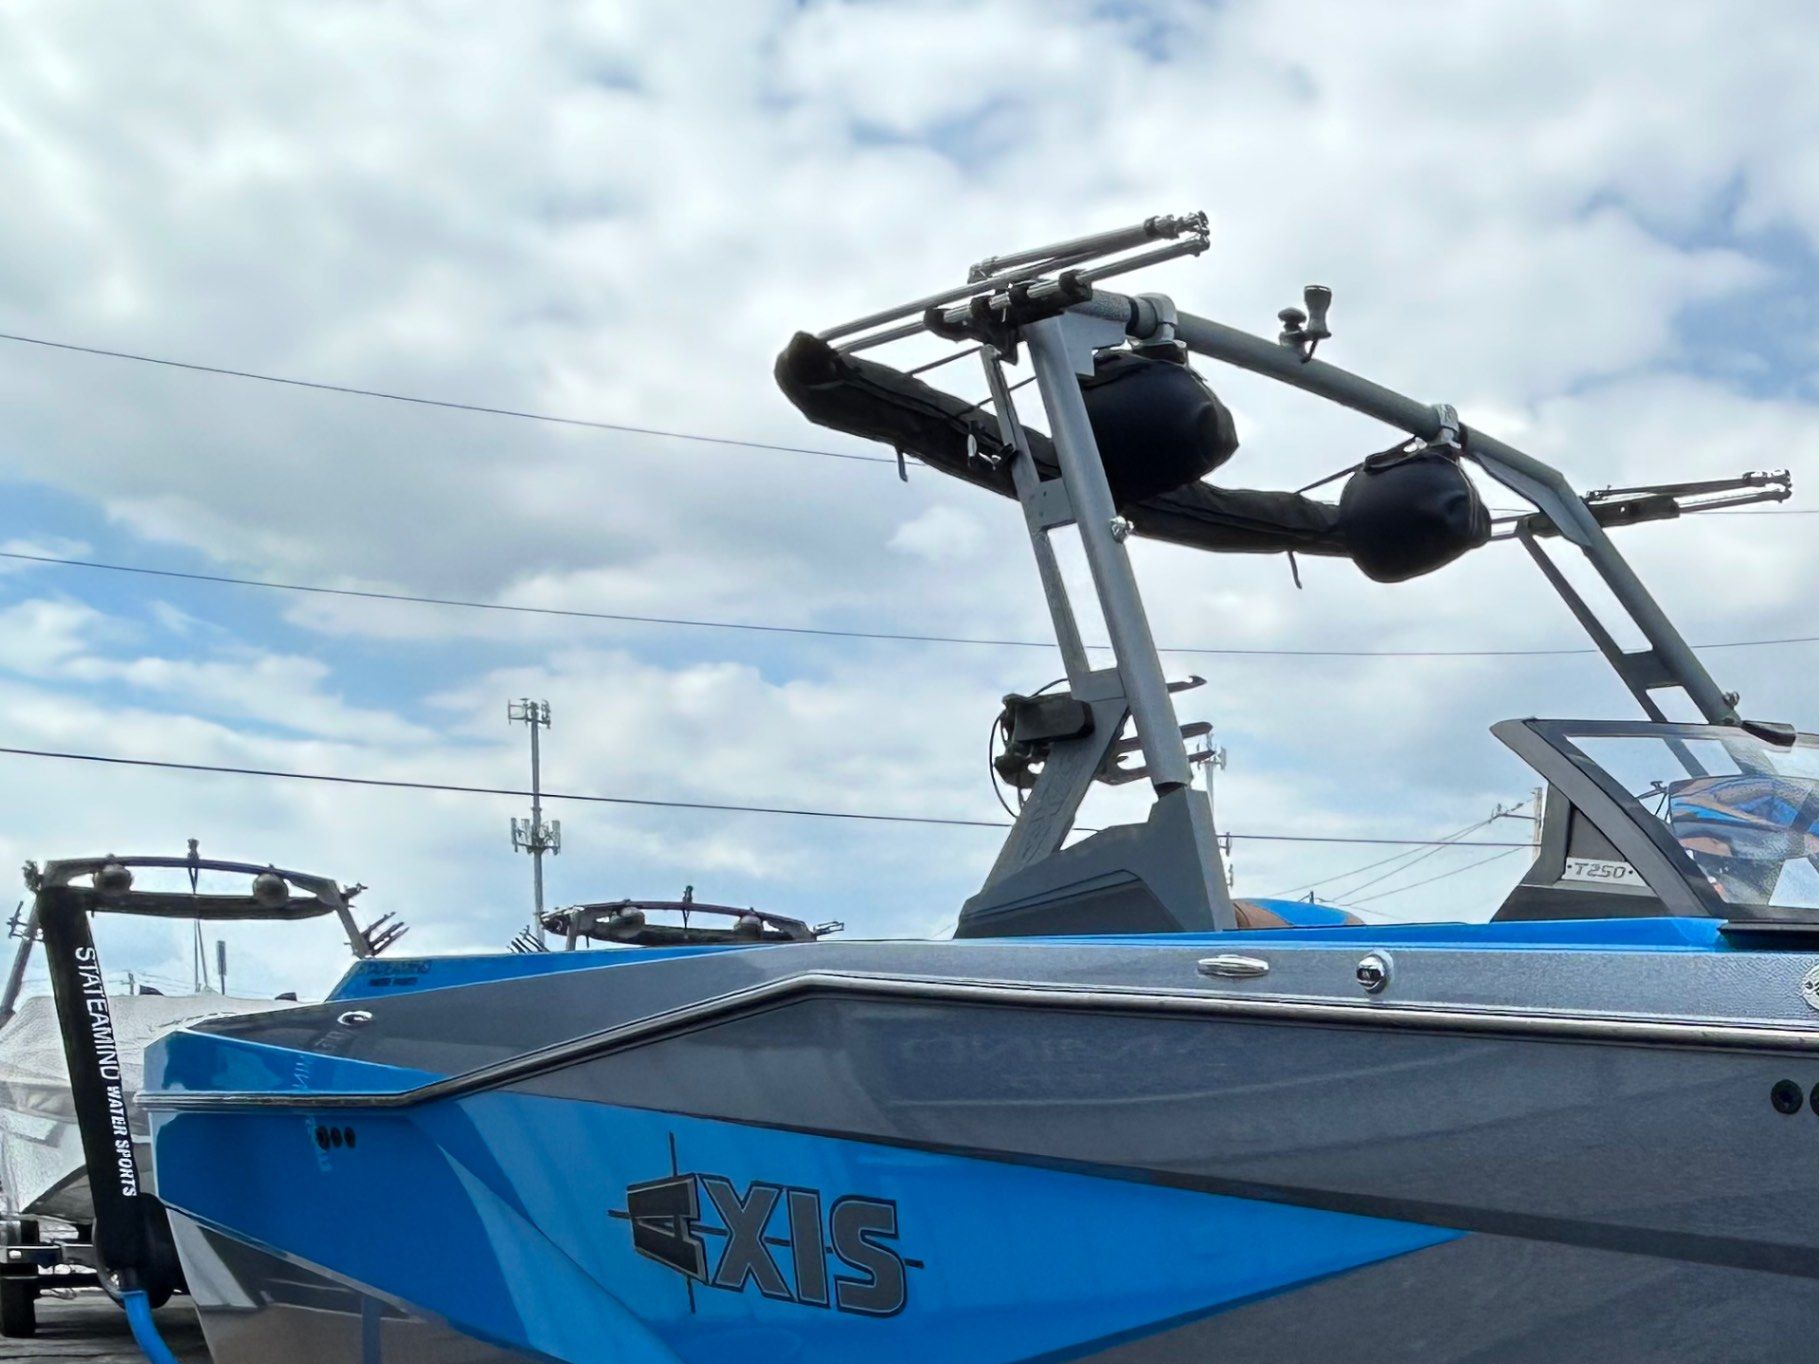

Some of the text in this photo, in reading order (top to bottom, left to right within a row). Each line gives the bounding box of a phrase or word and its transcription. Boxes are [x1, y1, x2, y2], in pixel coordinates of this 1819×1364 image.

[1574, 862, 1626, 878] T250
[75, 946, 137, 1197] STATEAMIND WATER SPORTS
[626, 1172, 908, 1318] AXIS
